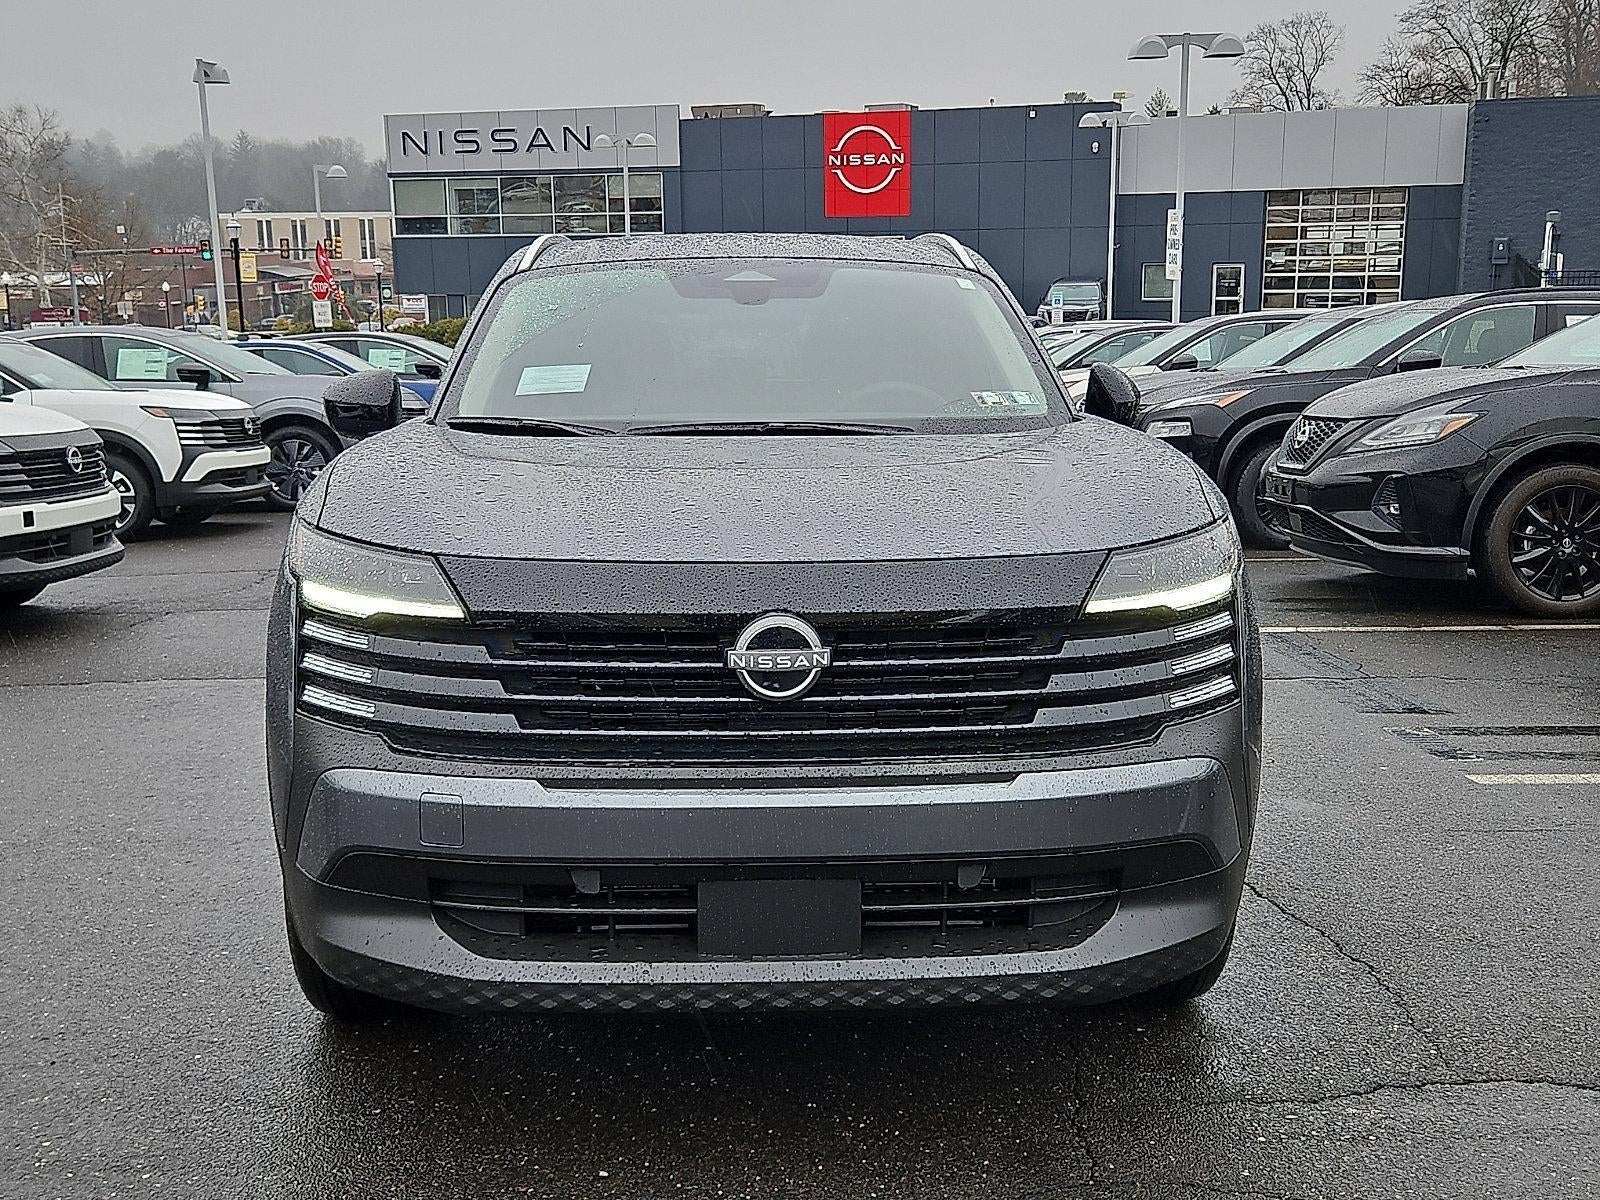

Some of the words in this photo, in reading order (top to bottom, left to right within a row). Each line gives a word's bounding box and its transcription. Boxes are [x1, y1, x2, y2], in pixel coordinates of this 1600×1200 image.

[401, 125, 592, 156] NISSAN
[828, 152, 905, 166] NISSAN
[174, 246, 197, 254] Fairway
[312, 282, 329, 293] STOP
[730, 653, 828, 668] NISSAN
